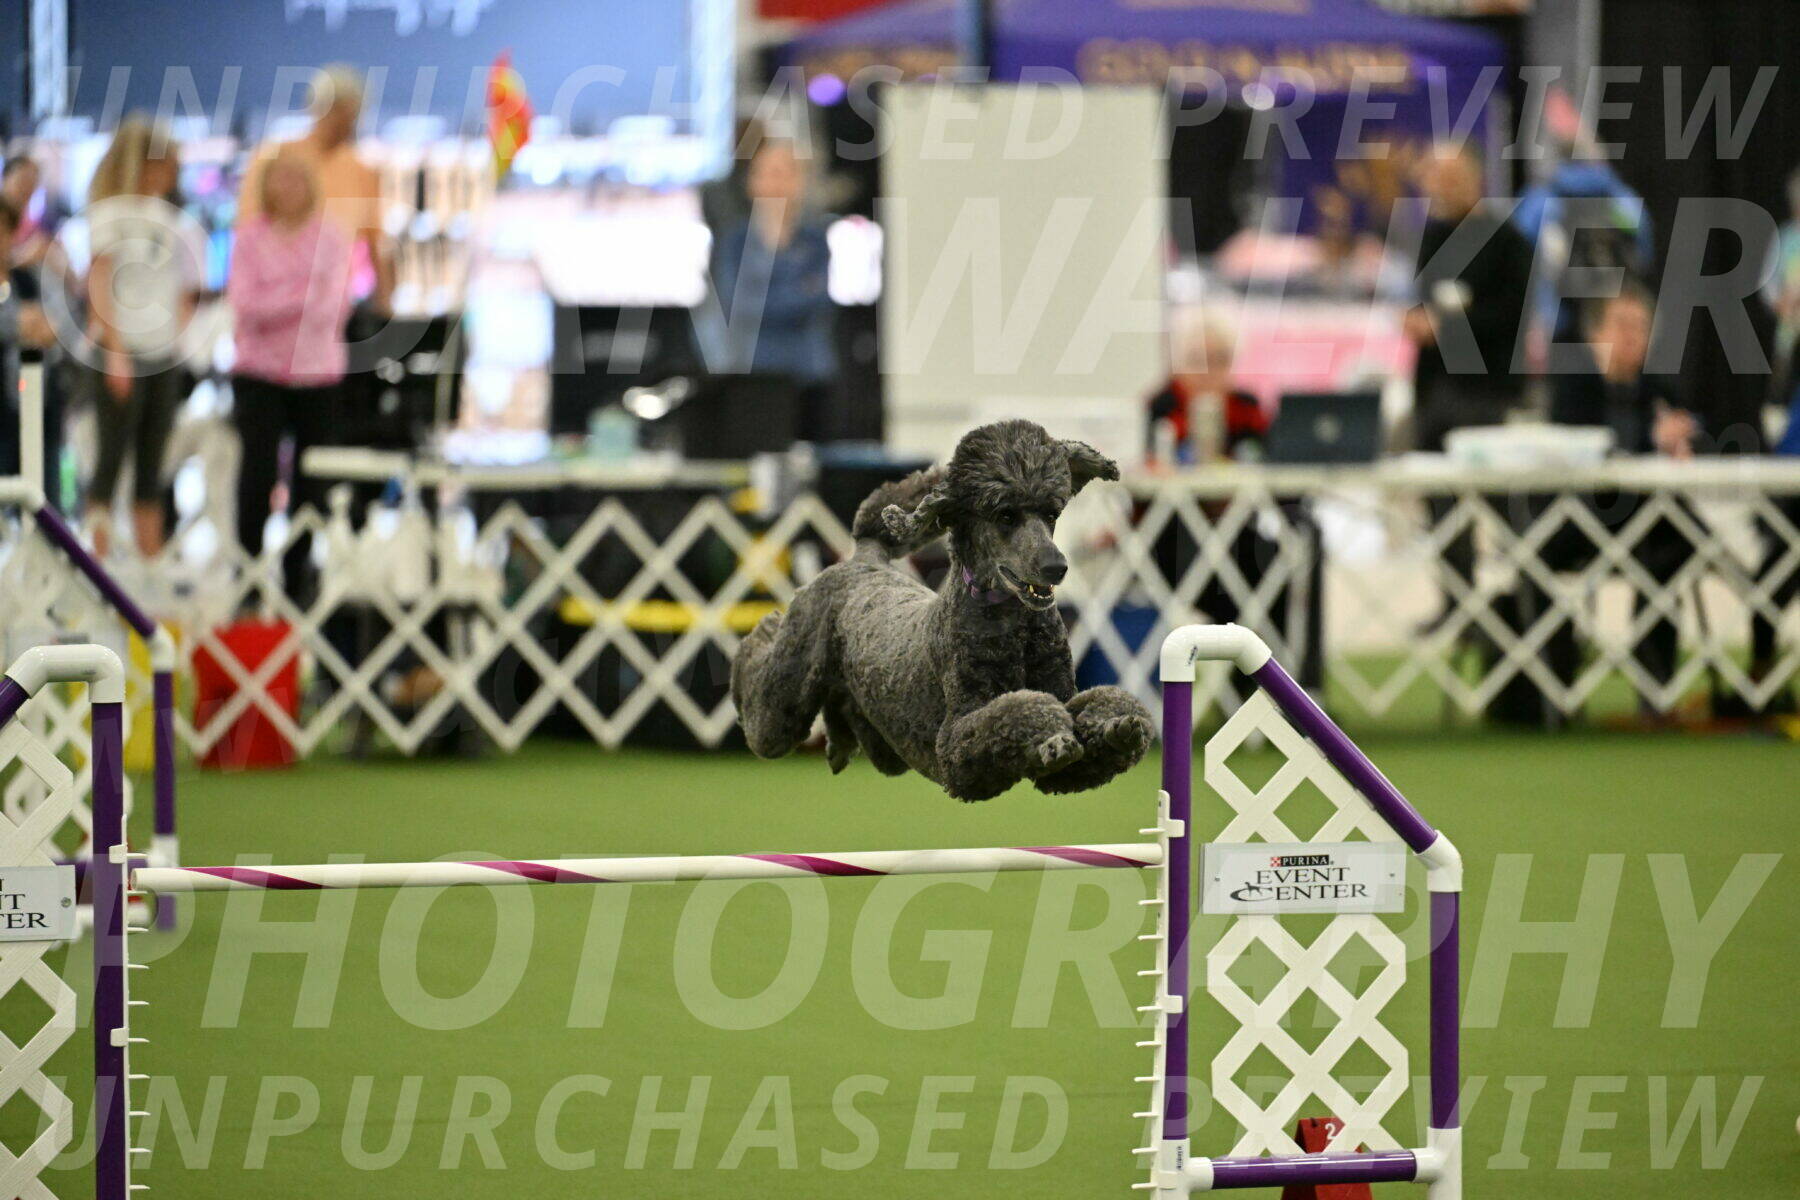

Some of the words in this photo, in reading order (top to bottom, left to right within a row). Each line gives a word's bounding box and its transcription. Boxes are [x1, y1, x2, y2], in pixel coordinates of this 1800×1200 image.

[1282, 855, 1329, 866] PURINA
[1256, 867, 1350, 884] EVENT
[1230, 883, 1369, 902] CENTER
[1324, 1122, 1337, 1140] 2
